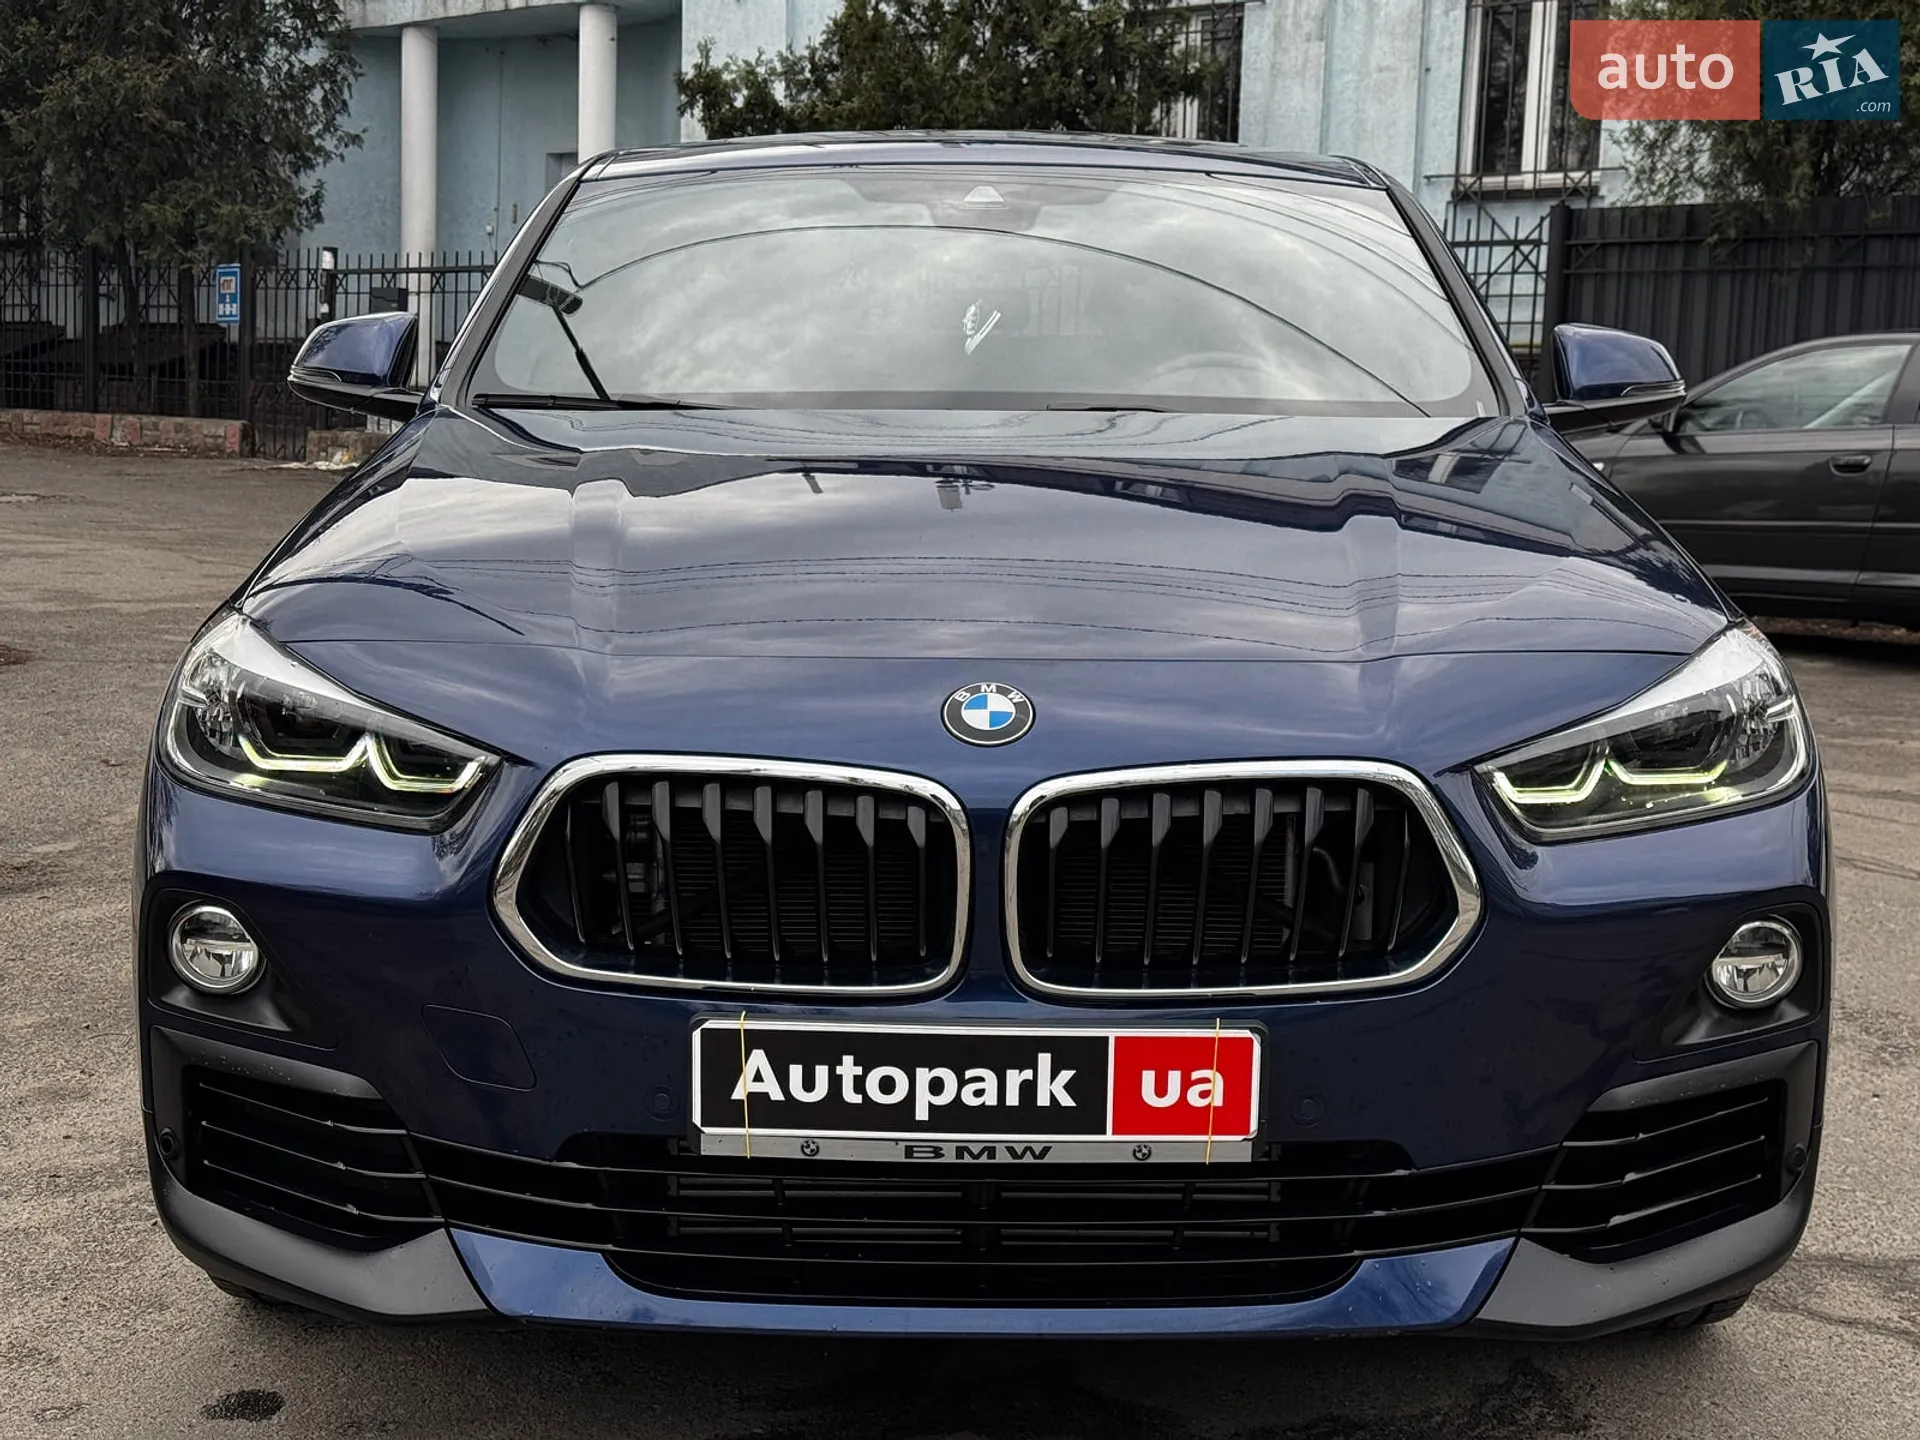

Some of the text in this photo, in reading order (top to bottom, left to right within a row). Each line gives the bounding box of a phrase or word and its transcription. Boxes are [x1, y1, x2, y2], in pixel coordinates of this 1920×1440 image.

[954, 683, 1024, 703] BMW
[731, 1049, 1224, 1121] Autopark ua
[904, 1144, 1052, 1161] BMW
